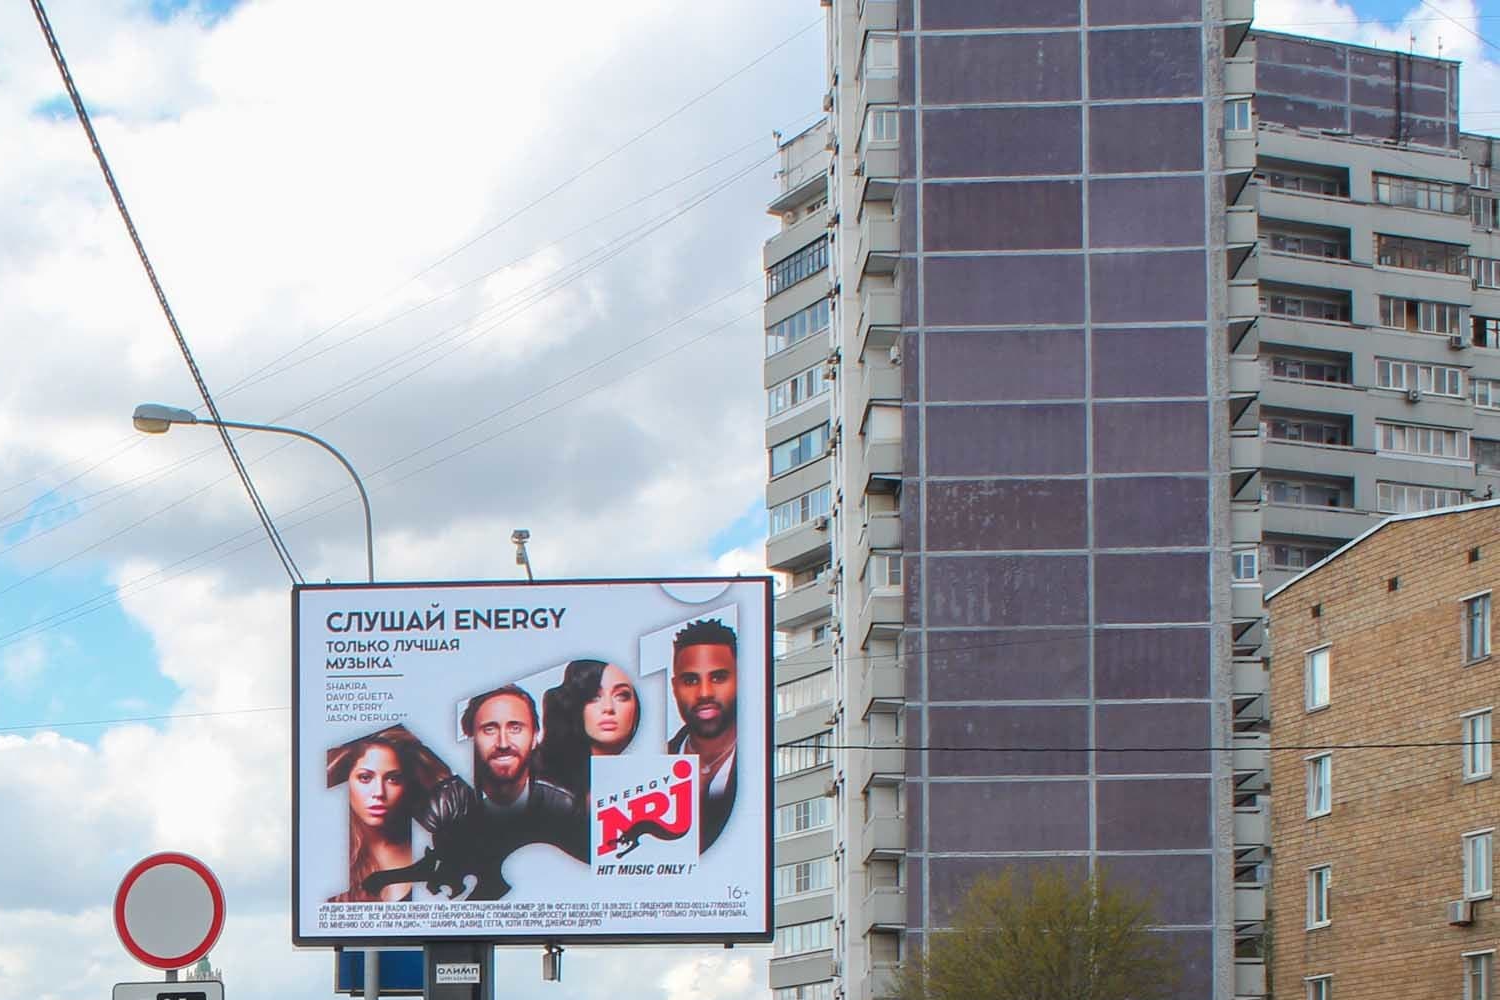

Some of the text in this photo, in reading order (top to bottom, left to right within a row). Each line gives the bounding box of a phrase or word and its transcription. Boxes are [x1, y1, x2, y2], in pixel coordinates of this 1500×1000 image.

[327, 602, 567, 633] СЛУШАЙ ENERGY
[326, 638, 460, 653] ТОЛЬКО ЛУЧШАЯ
[326, 682, 368, 691] SHAKIRA
[326, 692, 394, 701] DAVID GUETTA
[326, 703, 383, 712] KATY PERRY
[325, 714, 357, 722] JASON
[597, 776, 670, 808] ENERGY
[597, 864, 616, 875] HIT
[618, 864, 654, 875] MUSIC
[656, 864, 685, 875] ONLY
[727, 885, 750, 899] 16+
